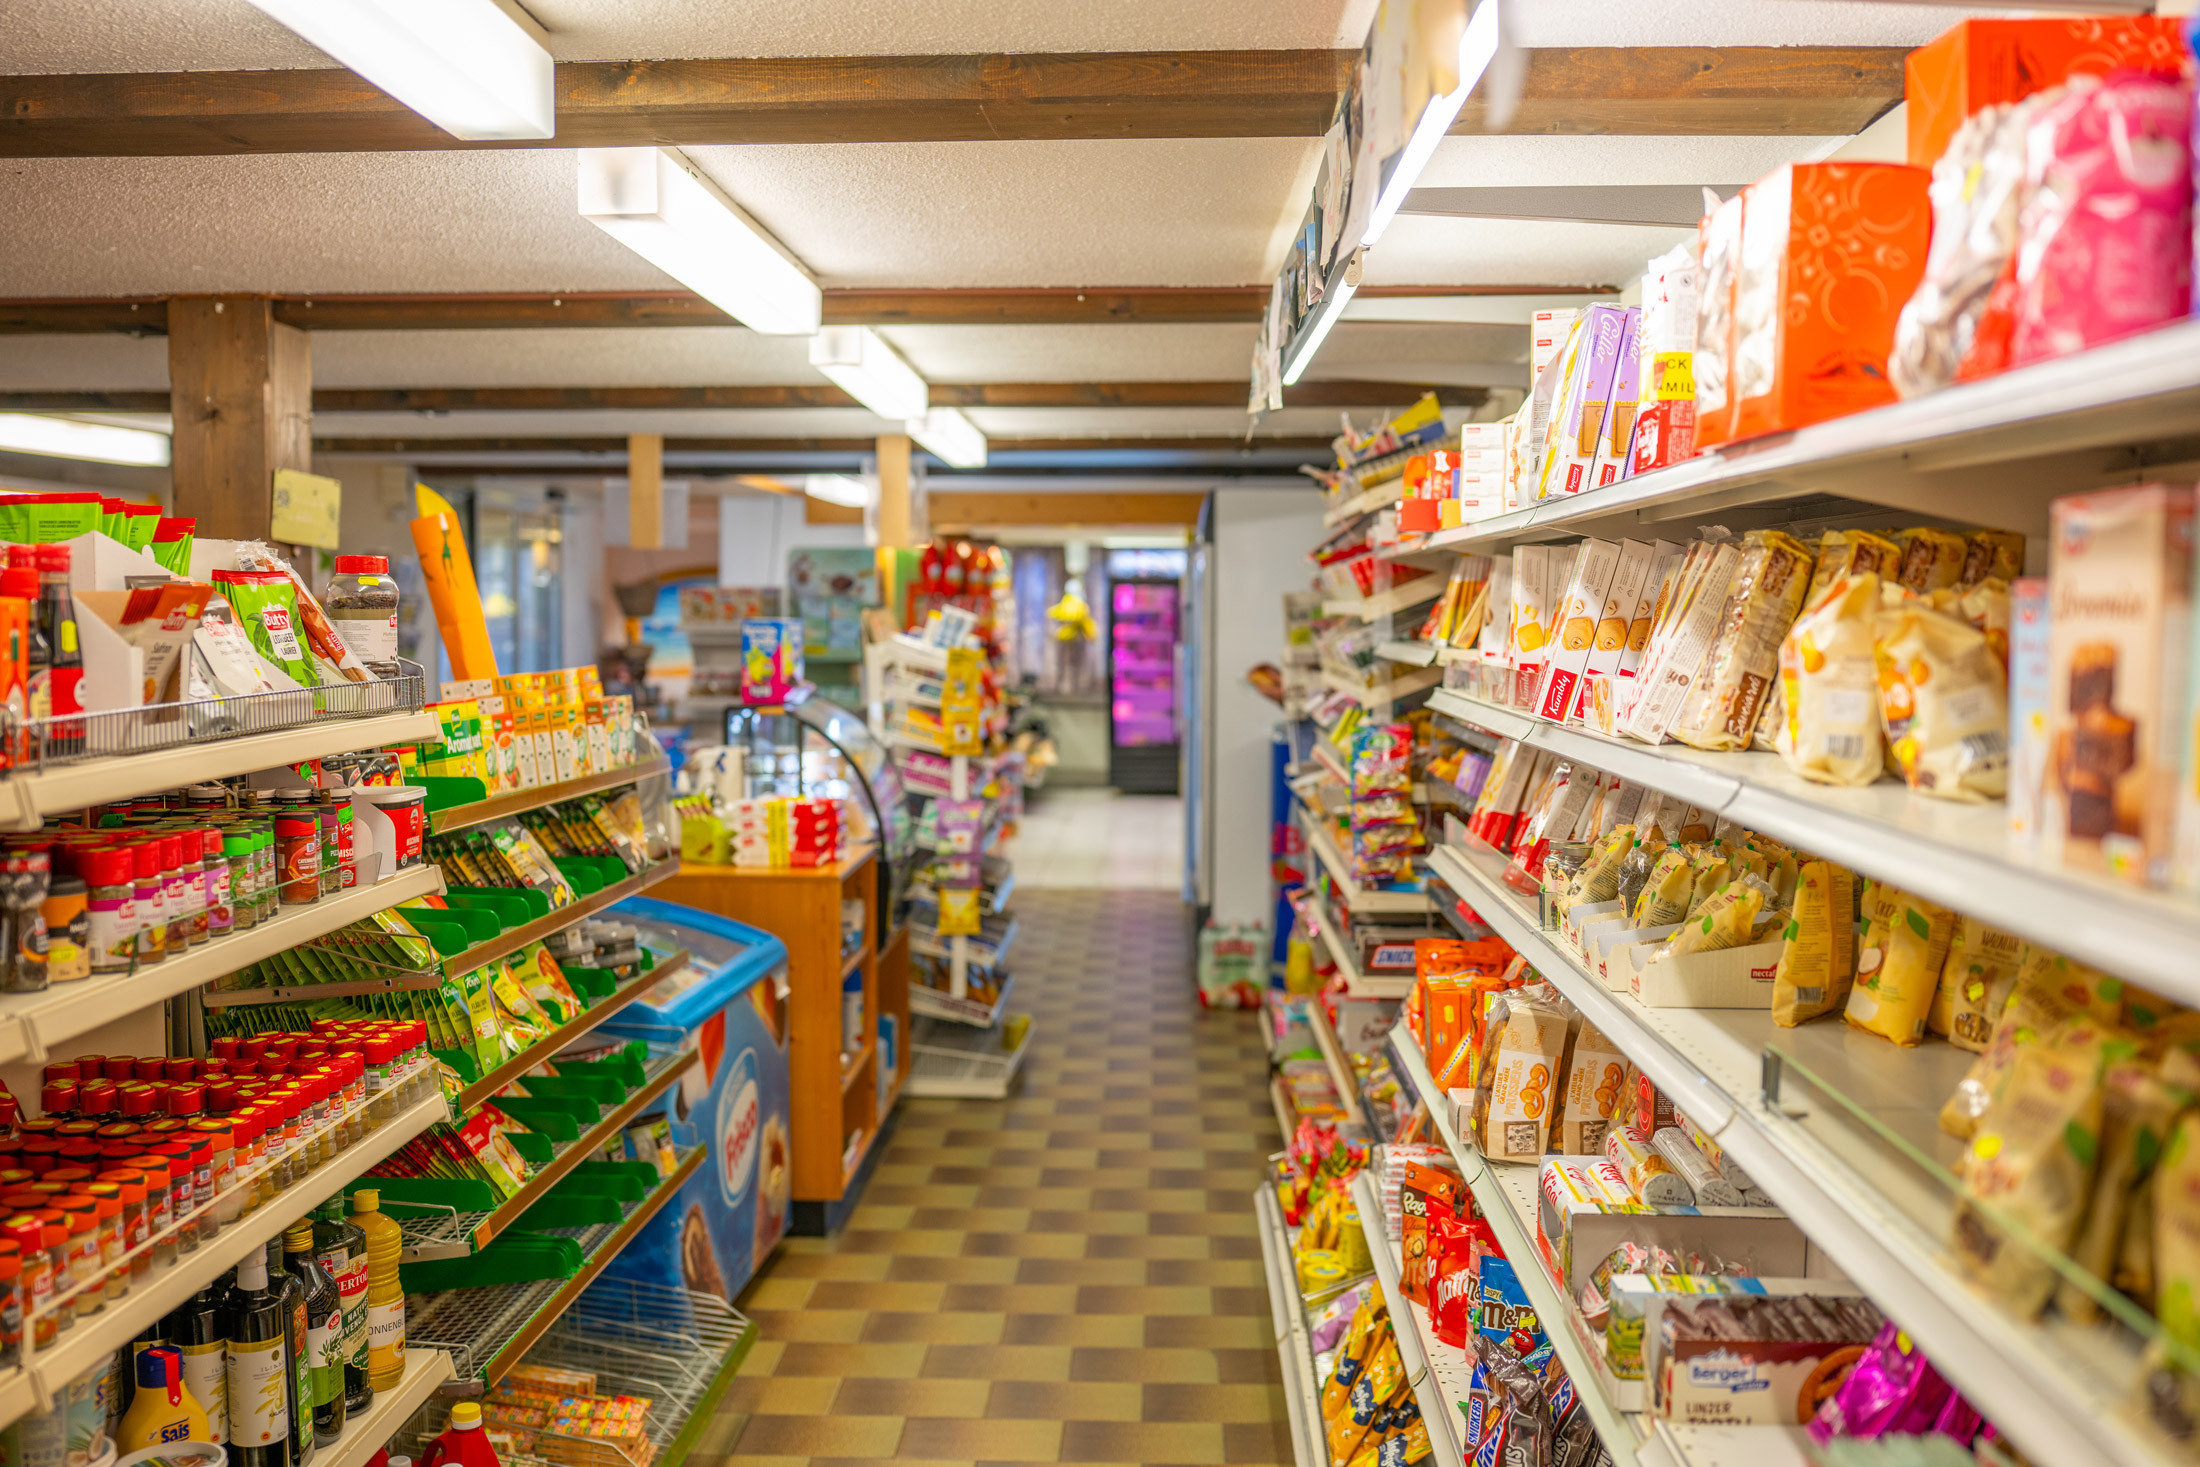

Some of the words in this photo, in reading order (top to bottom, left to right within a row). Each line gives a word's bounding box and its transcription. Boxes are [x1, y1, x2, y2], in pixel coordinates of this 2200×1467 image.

[1597, 313, 1620, 365] Cailler
[1662, 359, 1687, 370] CK
[263, 611, 290, 627] Butty
[1504, 1059, 1524, 1116] PRUSSIENS
[1403, 1192, 1426, 1217] Rag
[1693, 1366, 1748, 1381] Berger
[1686, 1402, 1732, 1415] LINZER
[1468, 1397, 1483, 1446] SNICKERS
[161, 1424, 190, 1444] Sais
